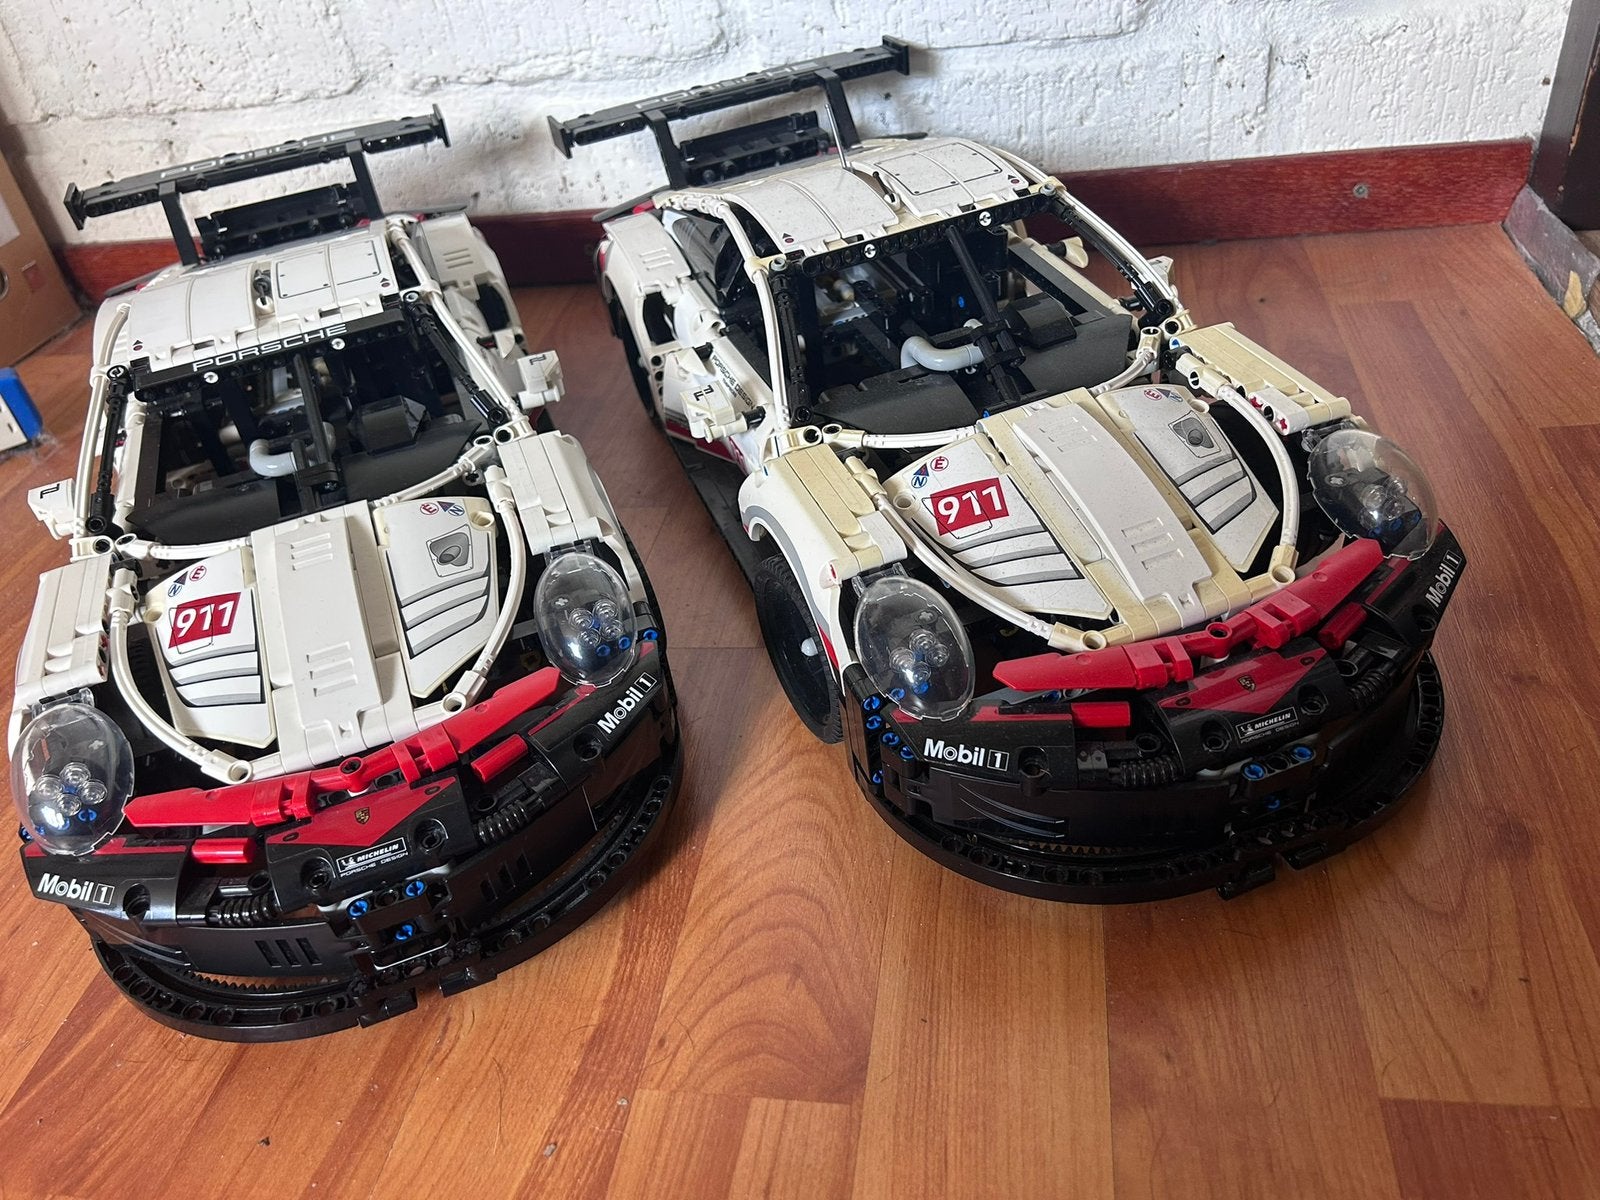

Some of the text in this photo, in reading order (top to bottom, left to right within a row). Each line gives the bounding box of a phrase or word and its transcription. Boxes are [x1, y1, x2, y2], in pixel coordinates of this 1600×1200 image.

[192, 323, 348, 373] PORSCHE
[937, 485, 1003, 525] 911
[1425, 562, 1456, 608] Mobil
[176, 600, 235, 638] 911
[597, 686, 645, 735] Mobil
[1254, 712, 1292, 730] MICHELIN
[923, 738, 986, 767] Mobil
[340, 851, 409, 878] PORSCHE DESIGN
[357, 843, 400, 863] MICHELIN
[37, 872, 95, 902] Mobil
